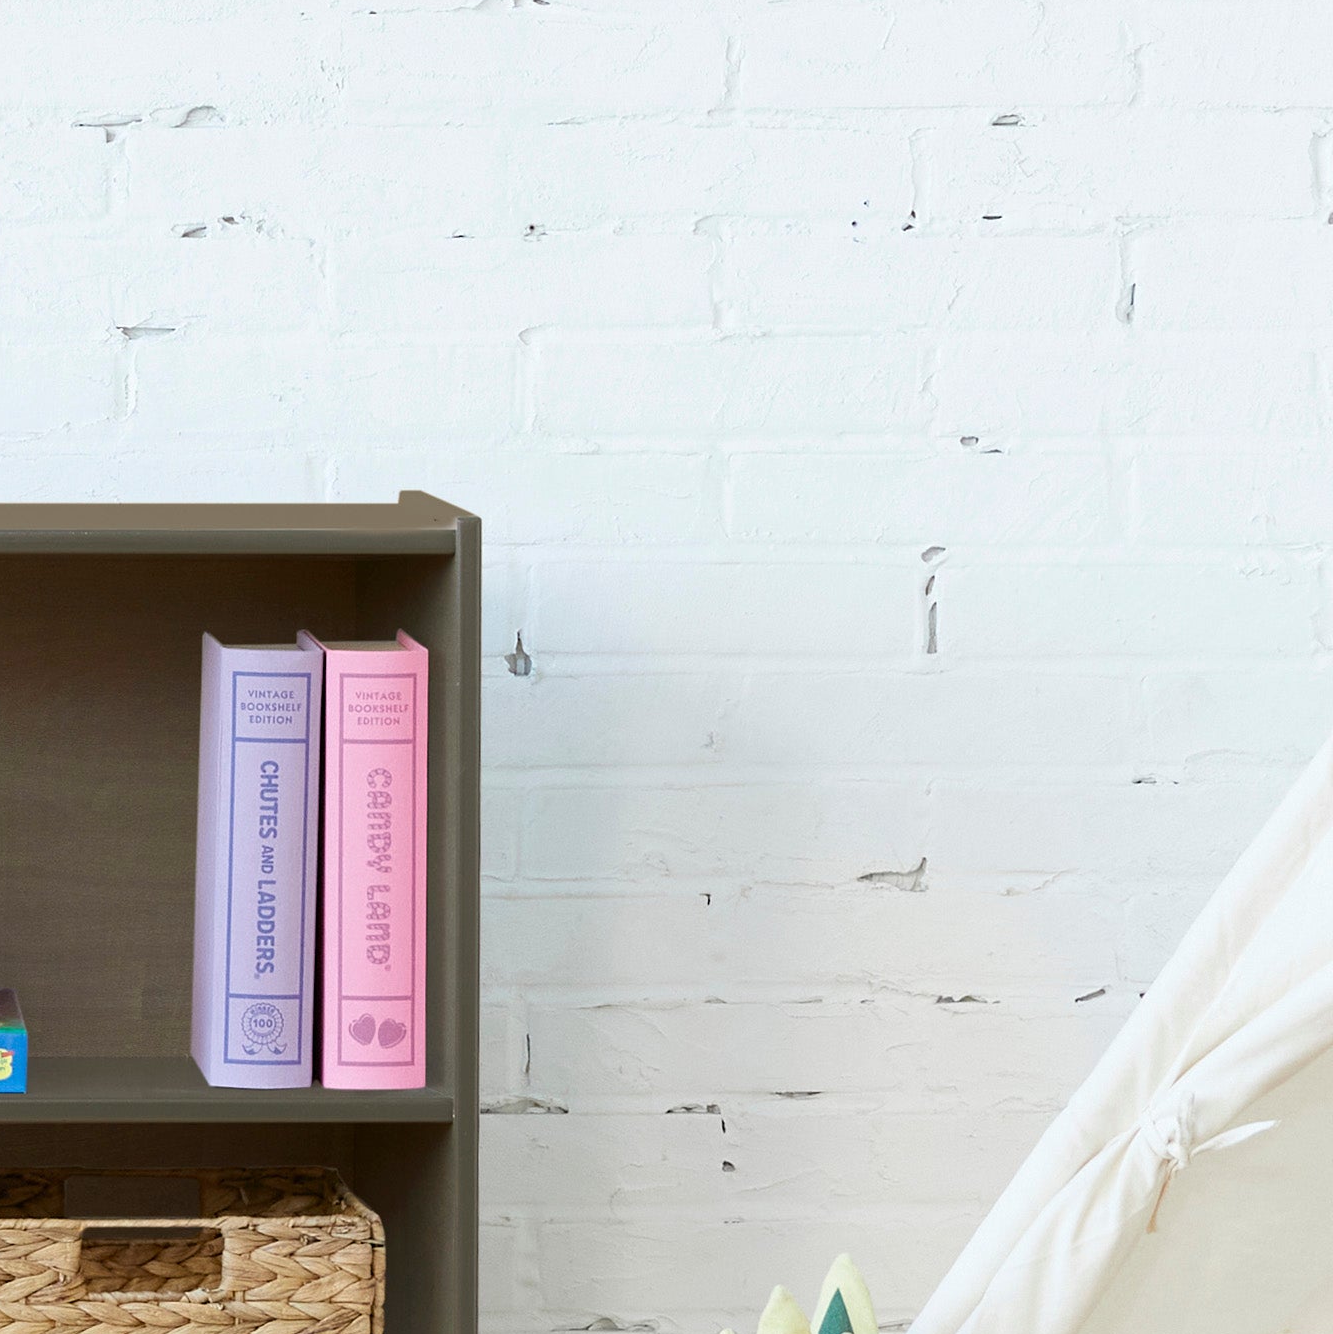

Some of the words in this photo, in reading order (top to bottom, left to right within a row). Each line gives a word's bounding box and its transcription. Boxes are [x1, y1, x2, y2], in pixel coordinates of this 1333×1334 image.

[248, 690, 294, 699] VINTAGE
[355, 691, 402, 701] VINTAGE
[240, 702, 302, 712] BOOKSHELF
[348, 704, 409, 713] BOOKSHELF
[249, 715, 293, 724] EDITION
[357, 717, 400, 726] EDITION
[258, 760, 279, 839] CHUTES
[261, 845, 274, 874] AND
[255, 879, 276, 974] LADDERS
[253, 1018, 273, 1028] 100
